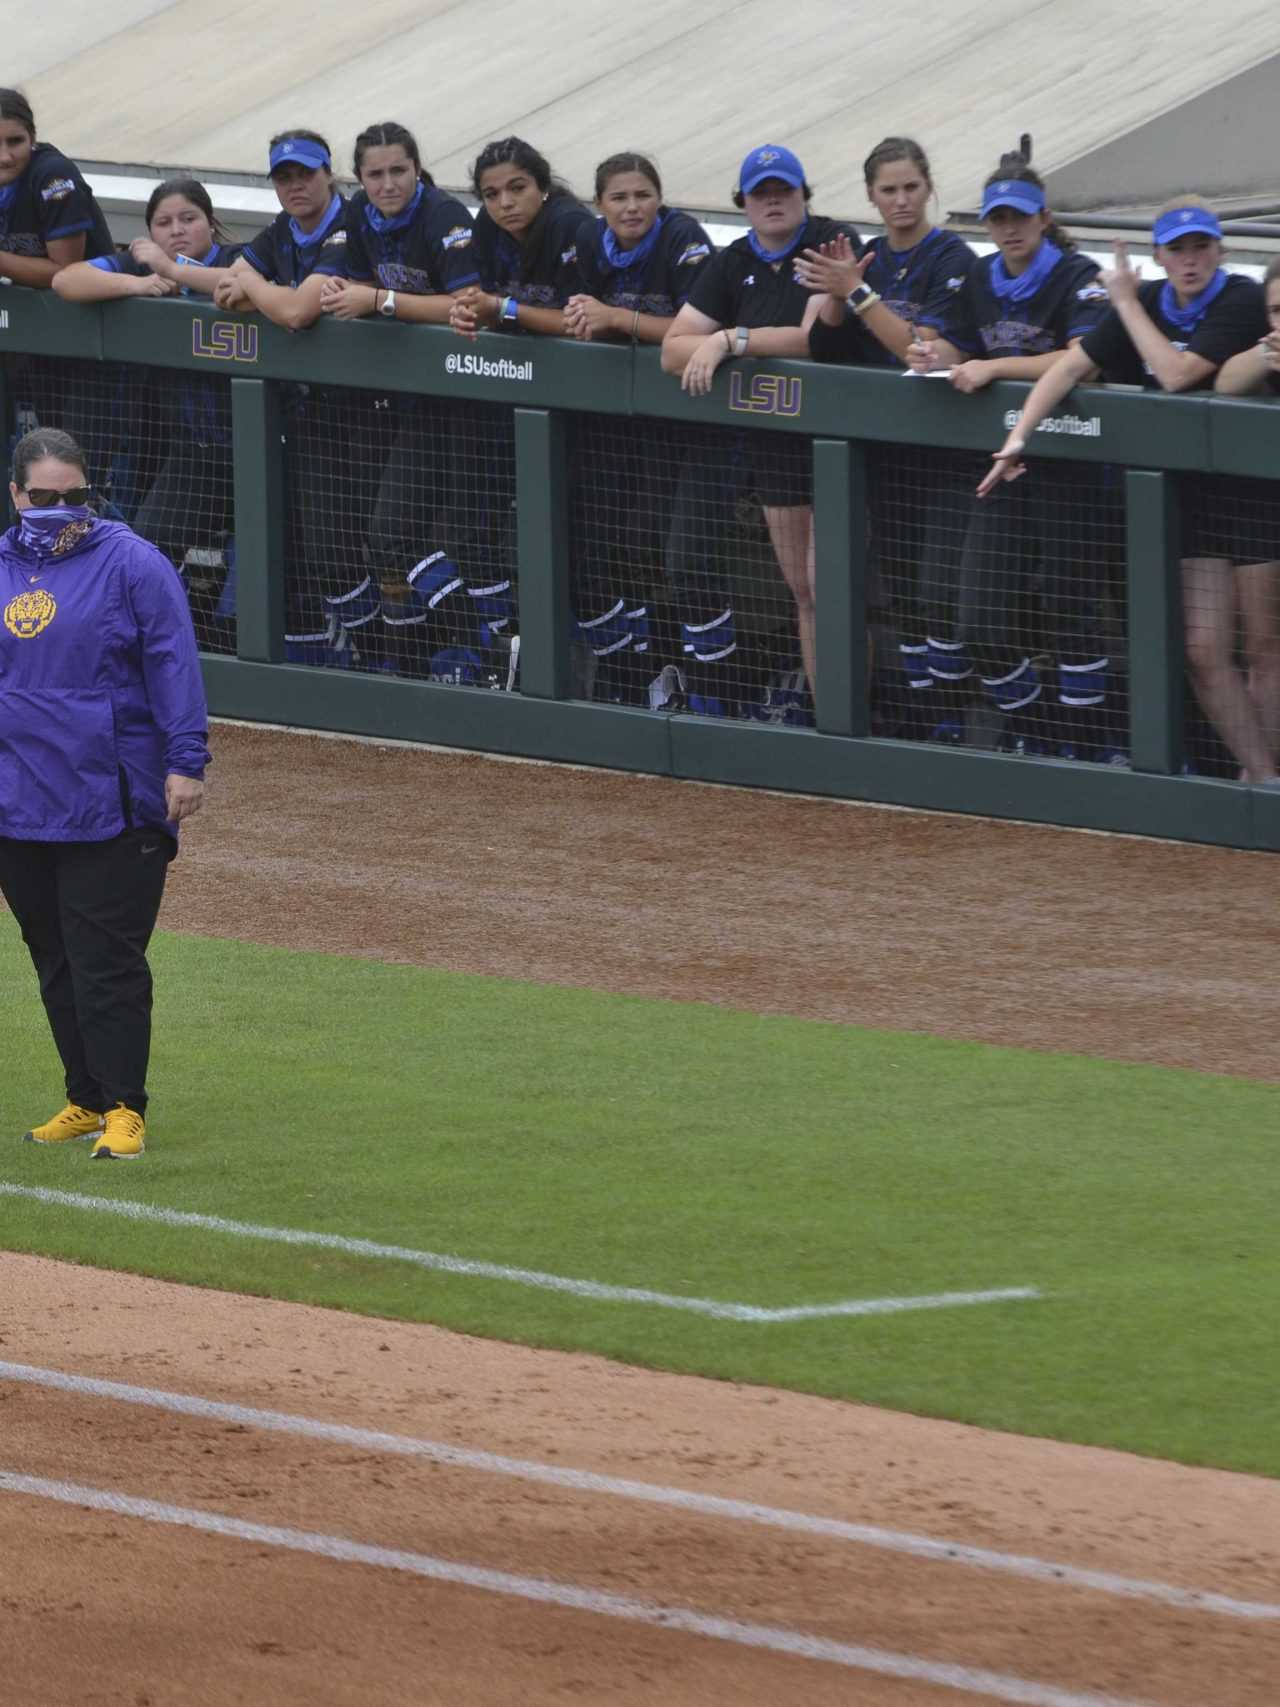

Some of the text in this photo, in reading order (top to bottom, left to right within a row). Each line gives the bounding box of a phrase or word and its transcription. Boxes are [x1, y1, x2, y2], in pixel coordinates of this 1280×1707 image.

[192, 318, 258, 362] LSU
[445, 353, 533, 380] @LSUsoftball
[729, 371, 802, 416] LSU
